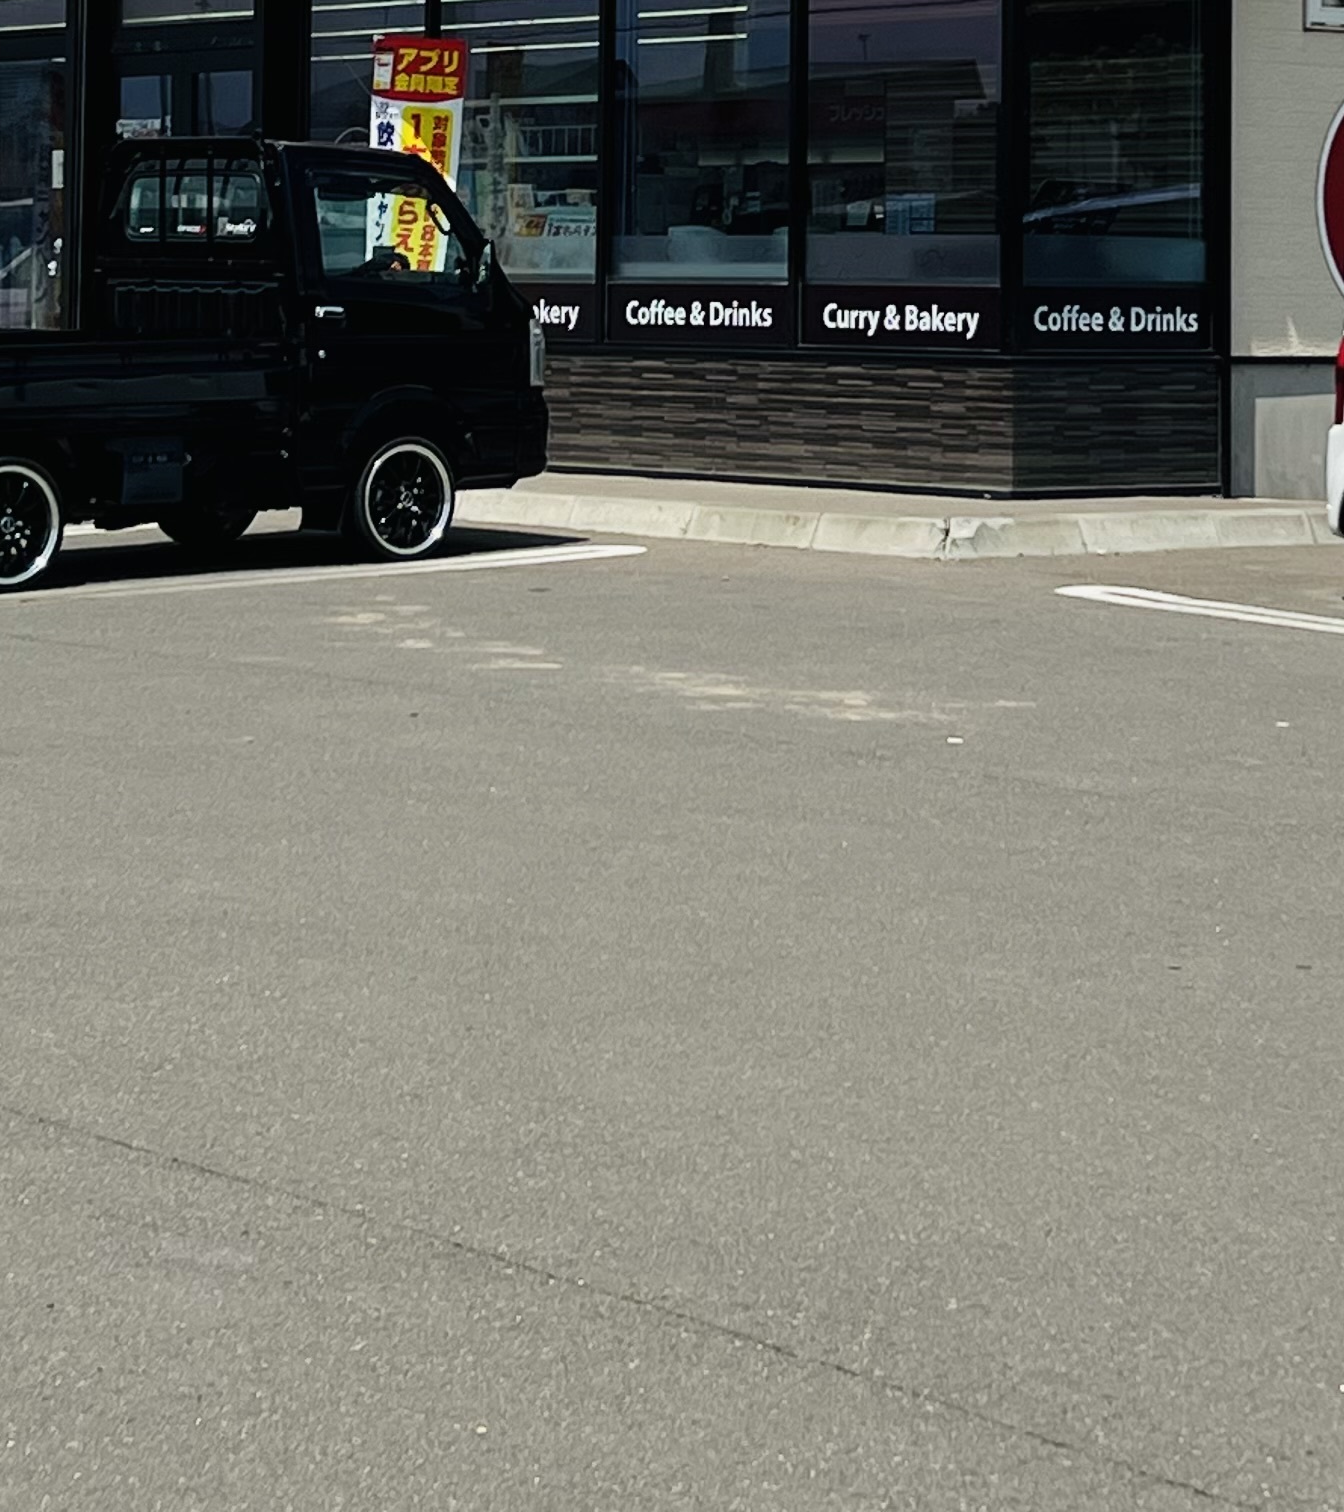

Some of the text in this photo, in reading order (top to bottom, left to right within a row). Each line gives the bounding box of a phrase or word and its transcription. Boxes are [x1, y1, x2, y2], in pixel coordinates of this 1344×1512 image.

[397, 48, 459, 74] アプリ
[625, 299, 773, 328] Coffee & Drinks
[822, 302, 980, 340] Curry & Bakery
[1033, 305, 1199, 333] Coffee & Drinks
